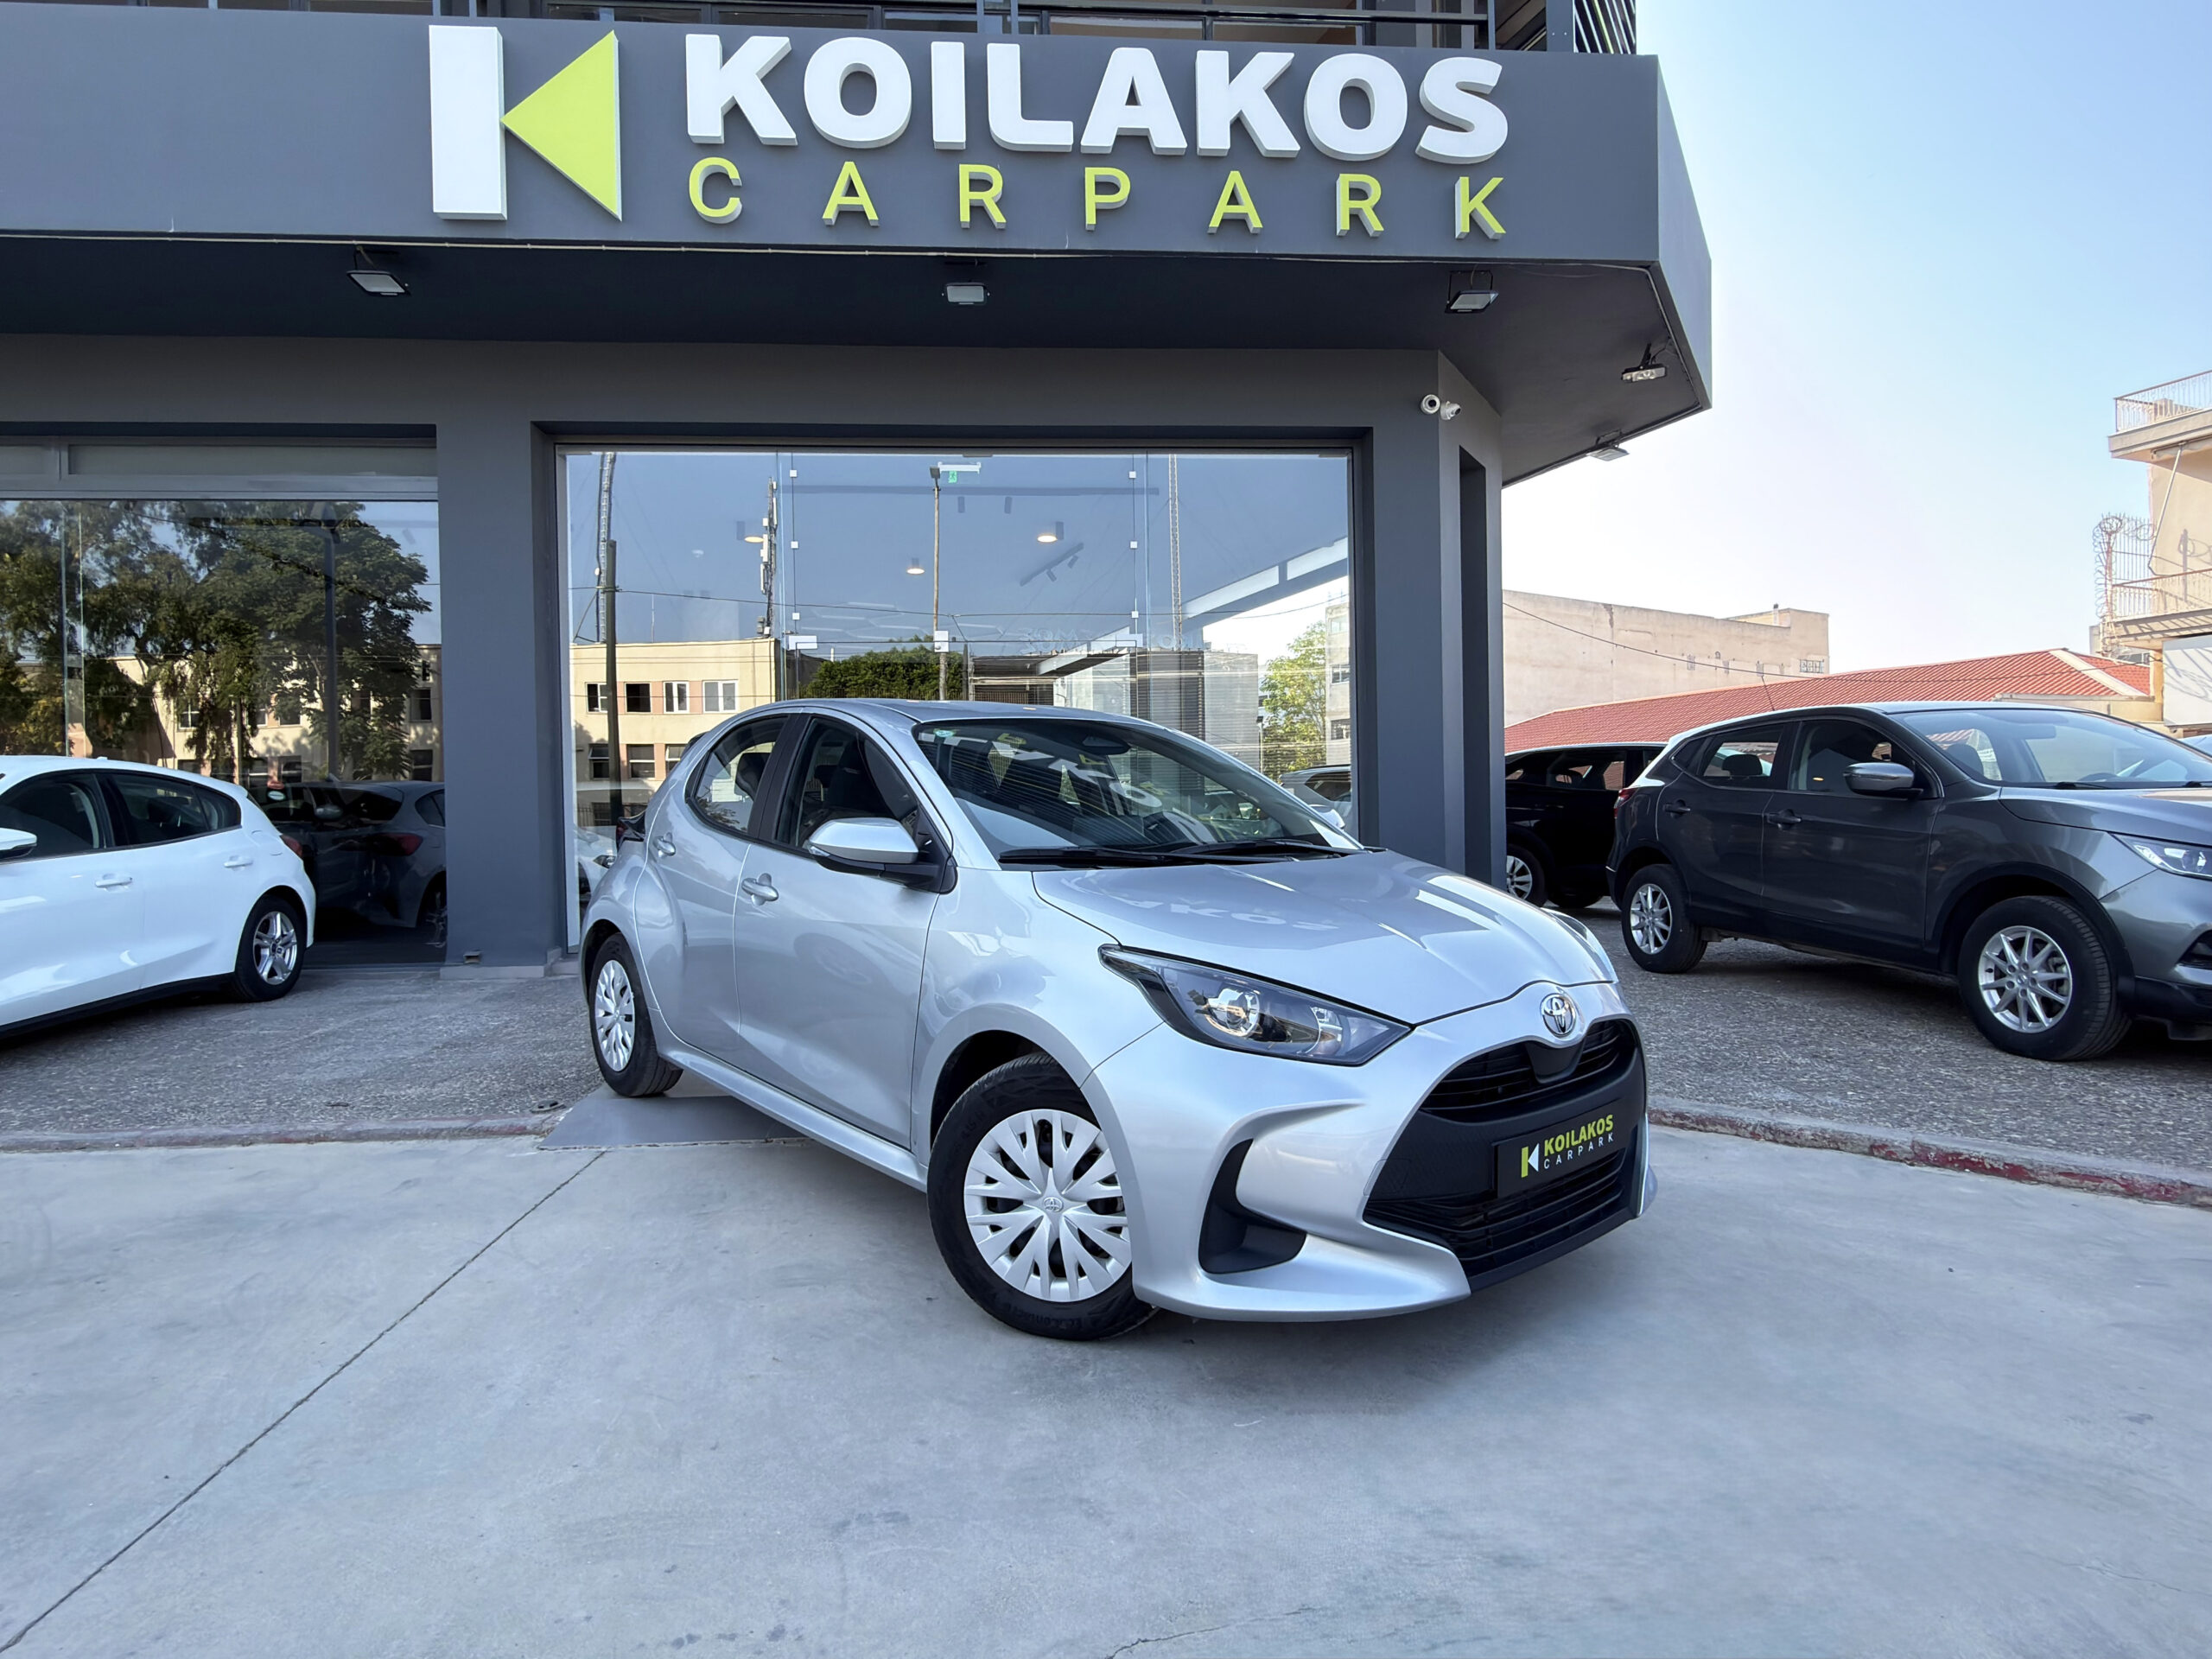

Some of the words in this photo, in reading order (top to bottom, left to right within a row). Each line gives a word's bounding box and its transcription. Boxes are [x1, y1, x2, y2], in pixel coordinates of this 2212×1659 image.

[685, 33, 1509, 165] KOILAKOS
[688, 156, 1507, 240] CARPARK
[1543, 1114, 1614, 1157] KOILAKOS
[1543, 1133, 1614, 1169] CARPARK
